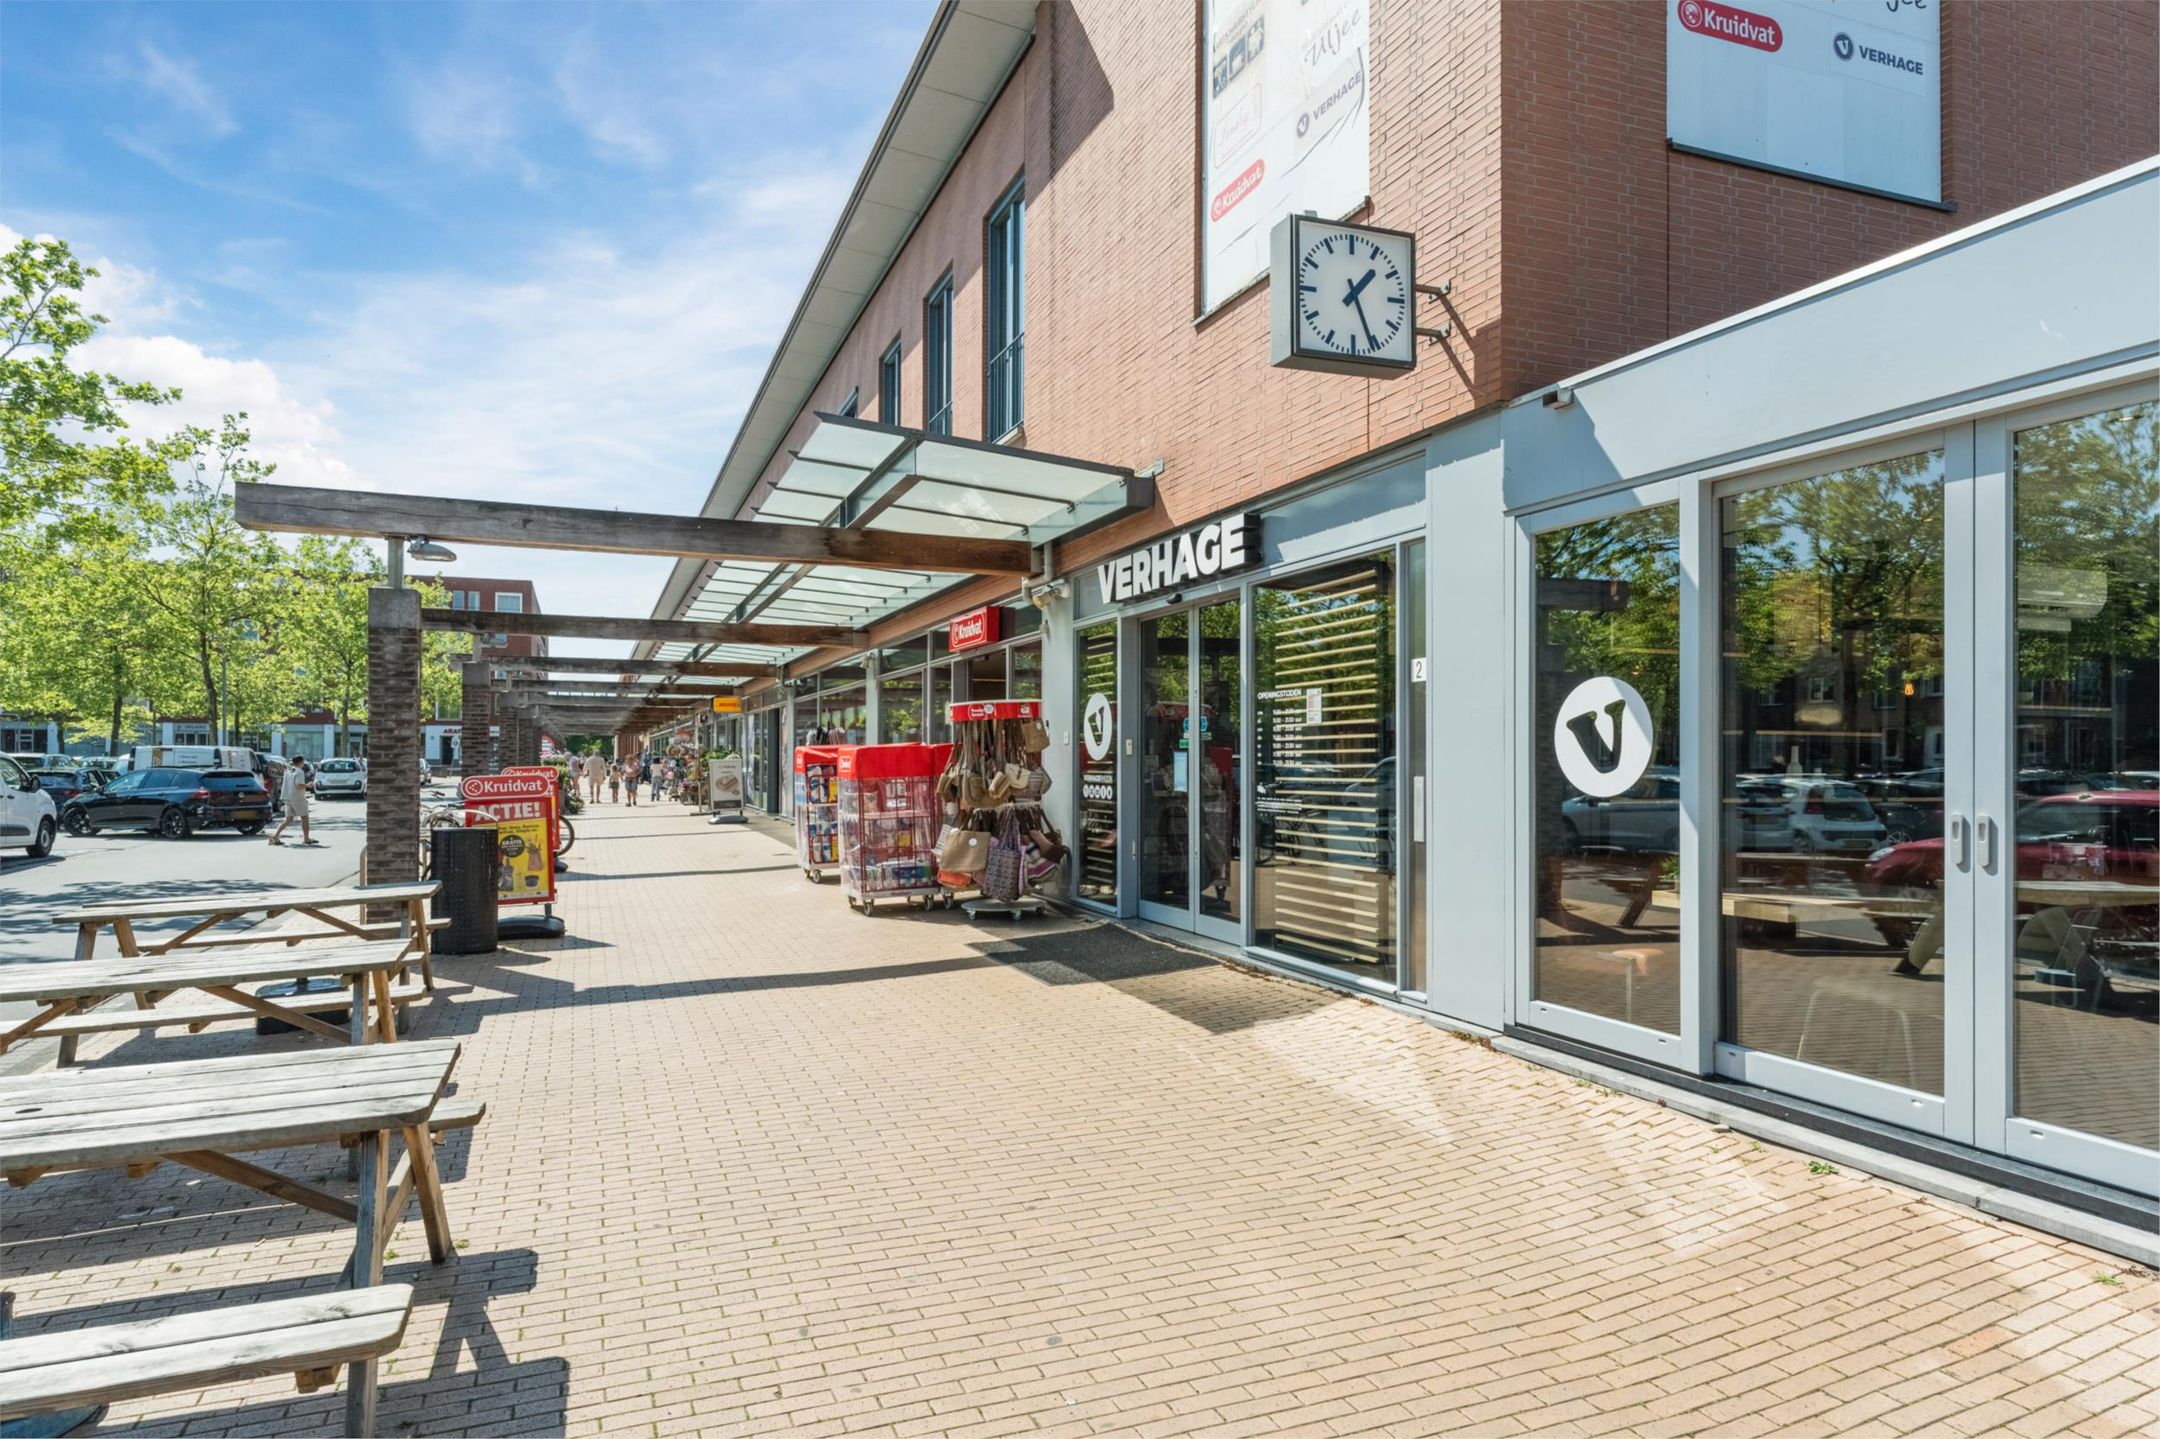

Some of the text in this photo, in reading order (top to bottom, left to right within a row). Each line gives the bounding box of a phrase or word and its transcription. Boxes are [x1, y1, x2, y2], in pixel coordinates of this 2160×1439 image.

[1704, 8, 1776, 45] Kruidvat
[1858, 45, 1924, 75] VERHAGE
[1313, 70, 1362, 120] VERHAGE
[1222, 167, 1262, 209] Kruidvat
[1097, 512, 1246, 605] VERHAGE
[959, 618, 982, 640] Kruidvat
[1416, 660, 1423, 679] 2
[484, 780, 543, 793] Kruidvat
[475, 801, 541, 821] ACTIE!
